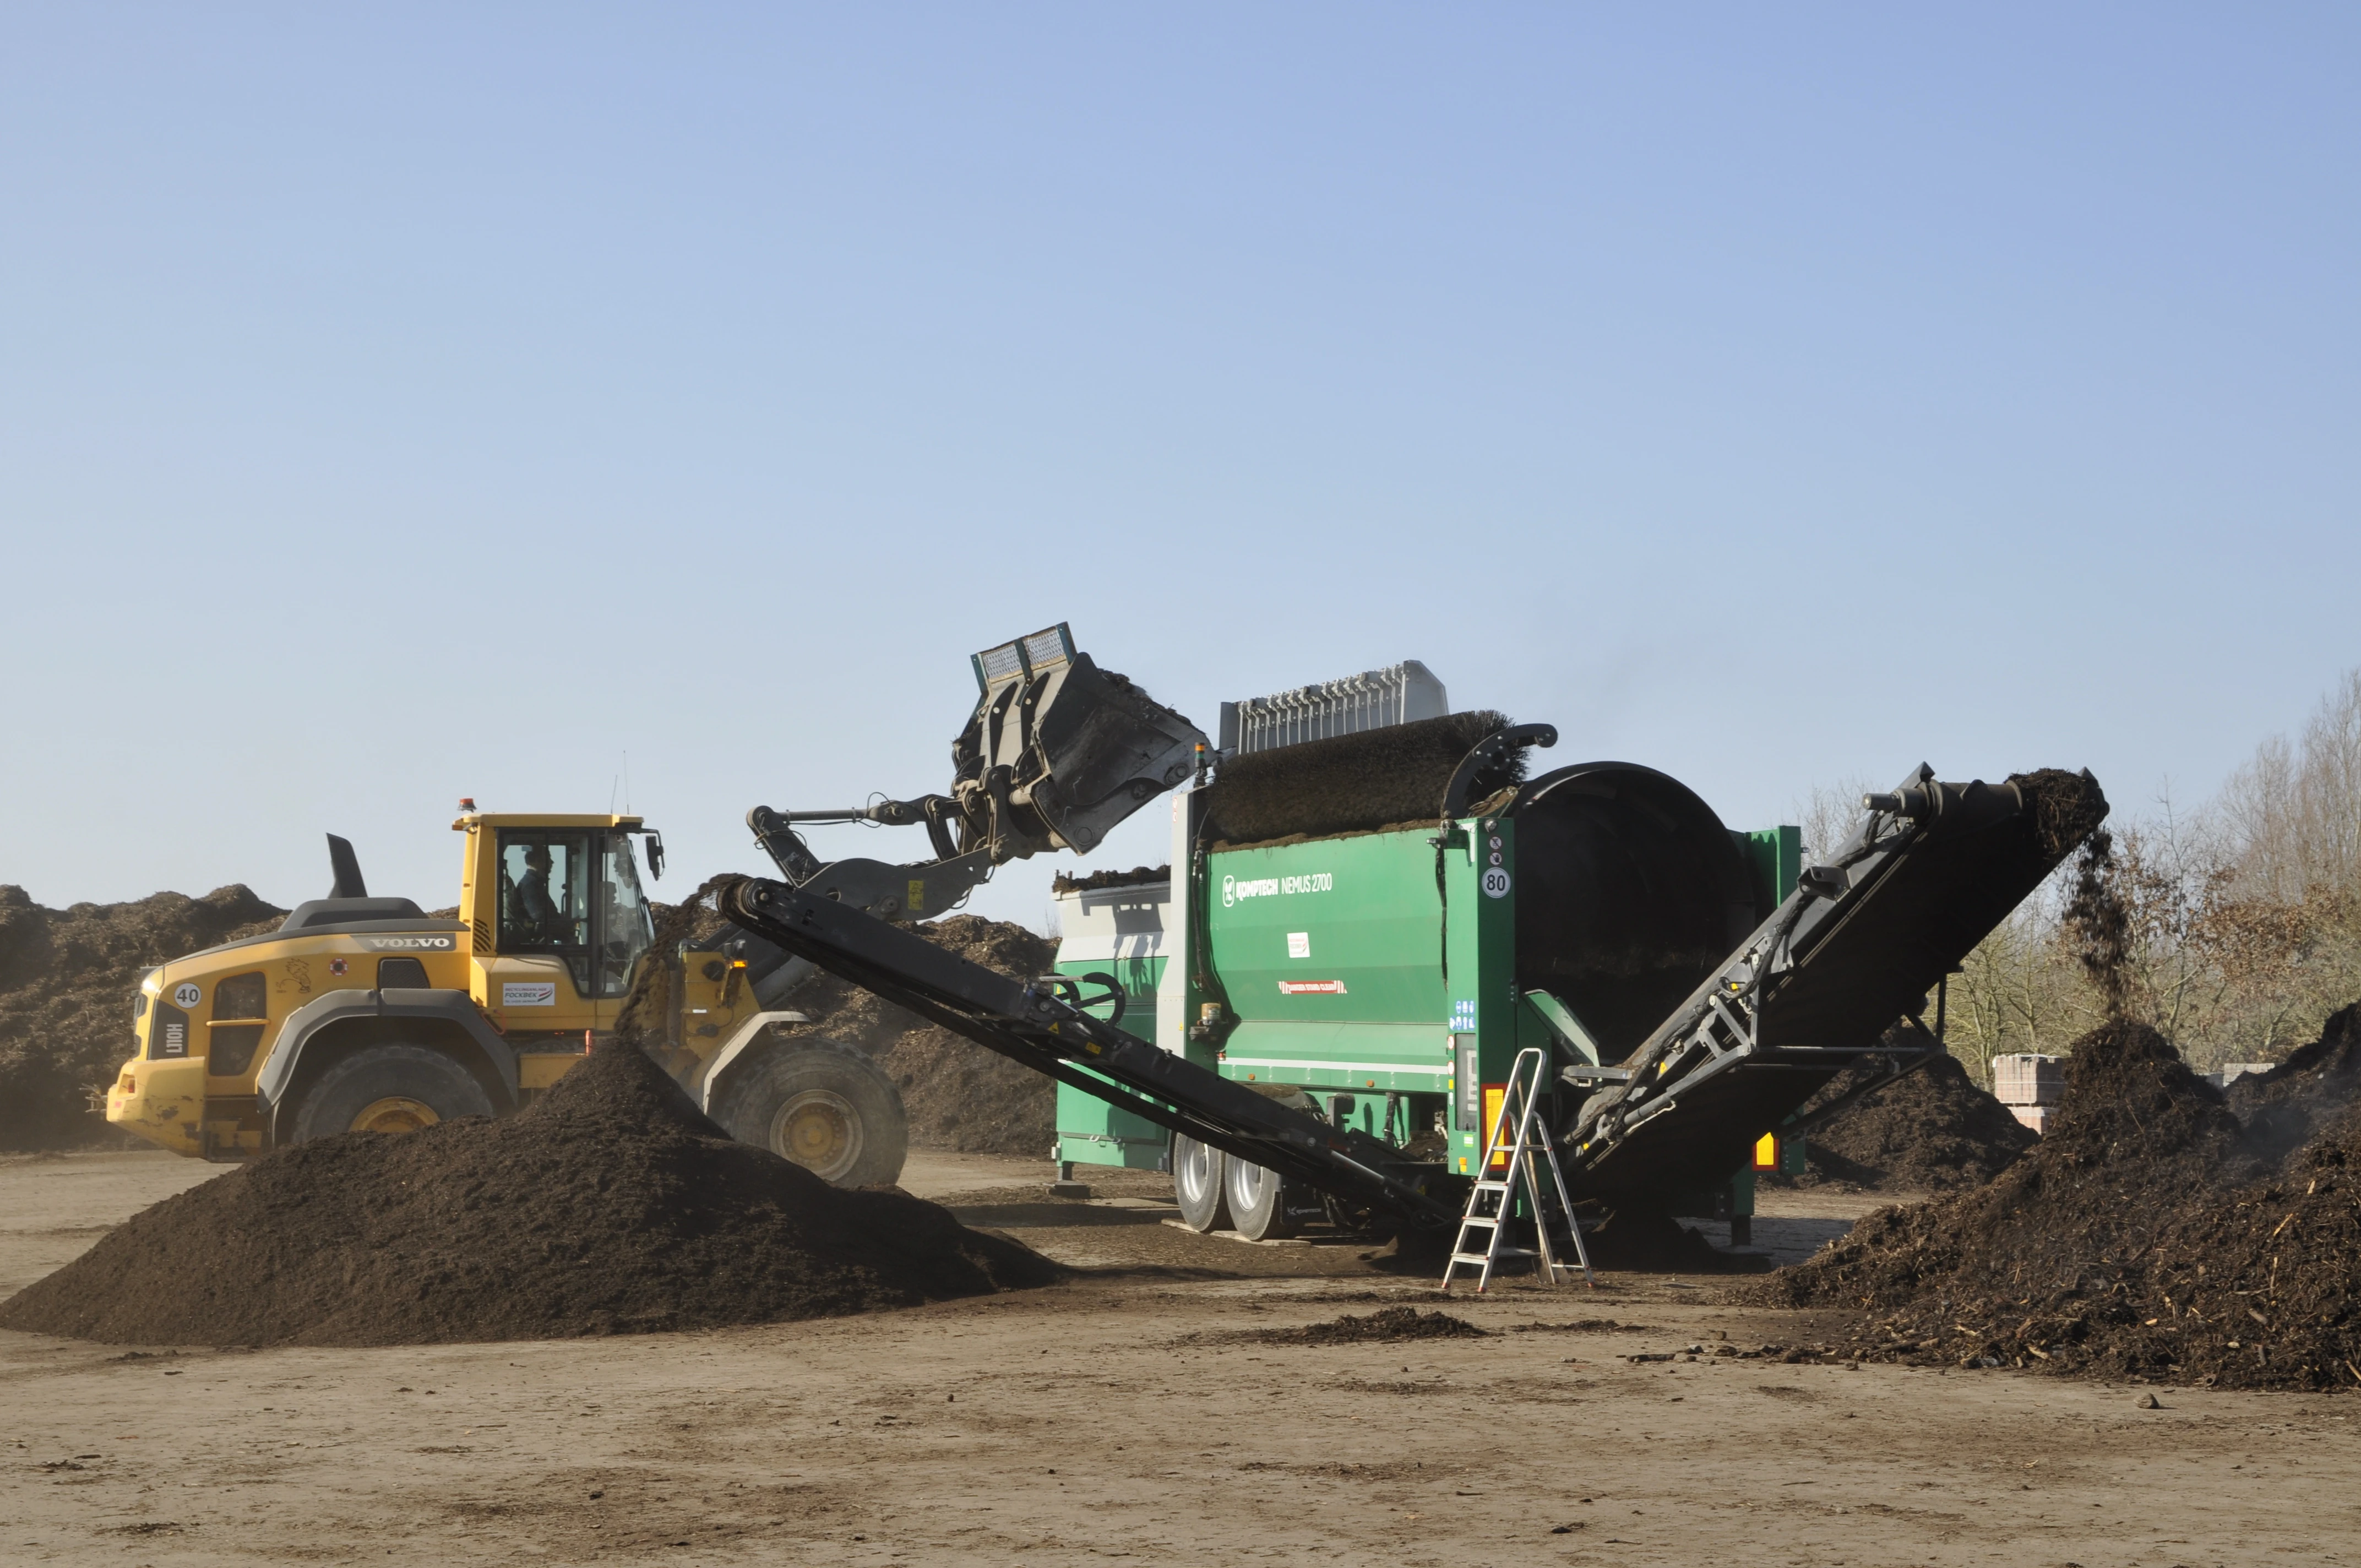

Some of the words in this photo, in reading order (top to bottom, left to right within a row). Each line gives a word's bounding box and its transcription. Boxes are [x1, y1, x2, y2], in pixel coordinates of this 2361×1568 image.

[1236, 878, 1279, 901] KOMPTECH
[1281, 874, 1311, 894] NEMUS
[1312, 873, 1332, 892] 2700
[1487, 874, 1506, 891] 80
[369, 938, 450, 948] VOLVO
[176, 989, 199, 1002] 40
[166, 1023, 183, 1053] L110H
